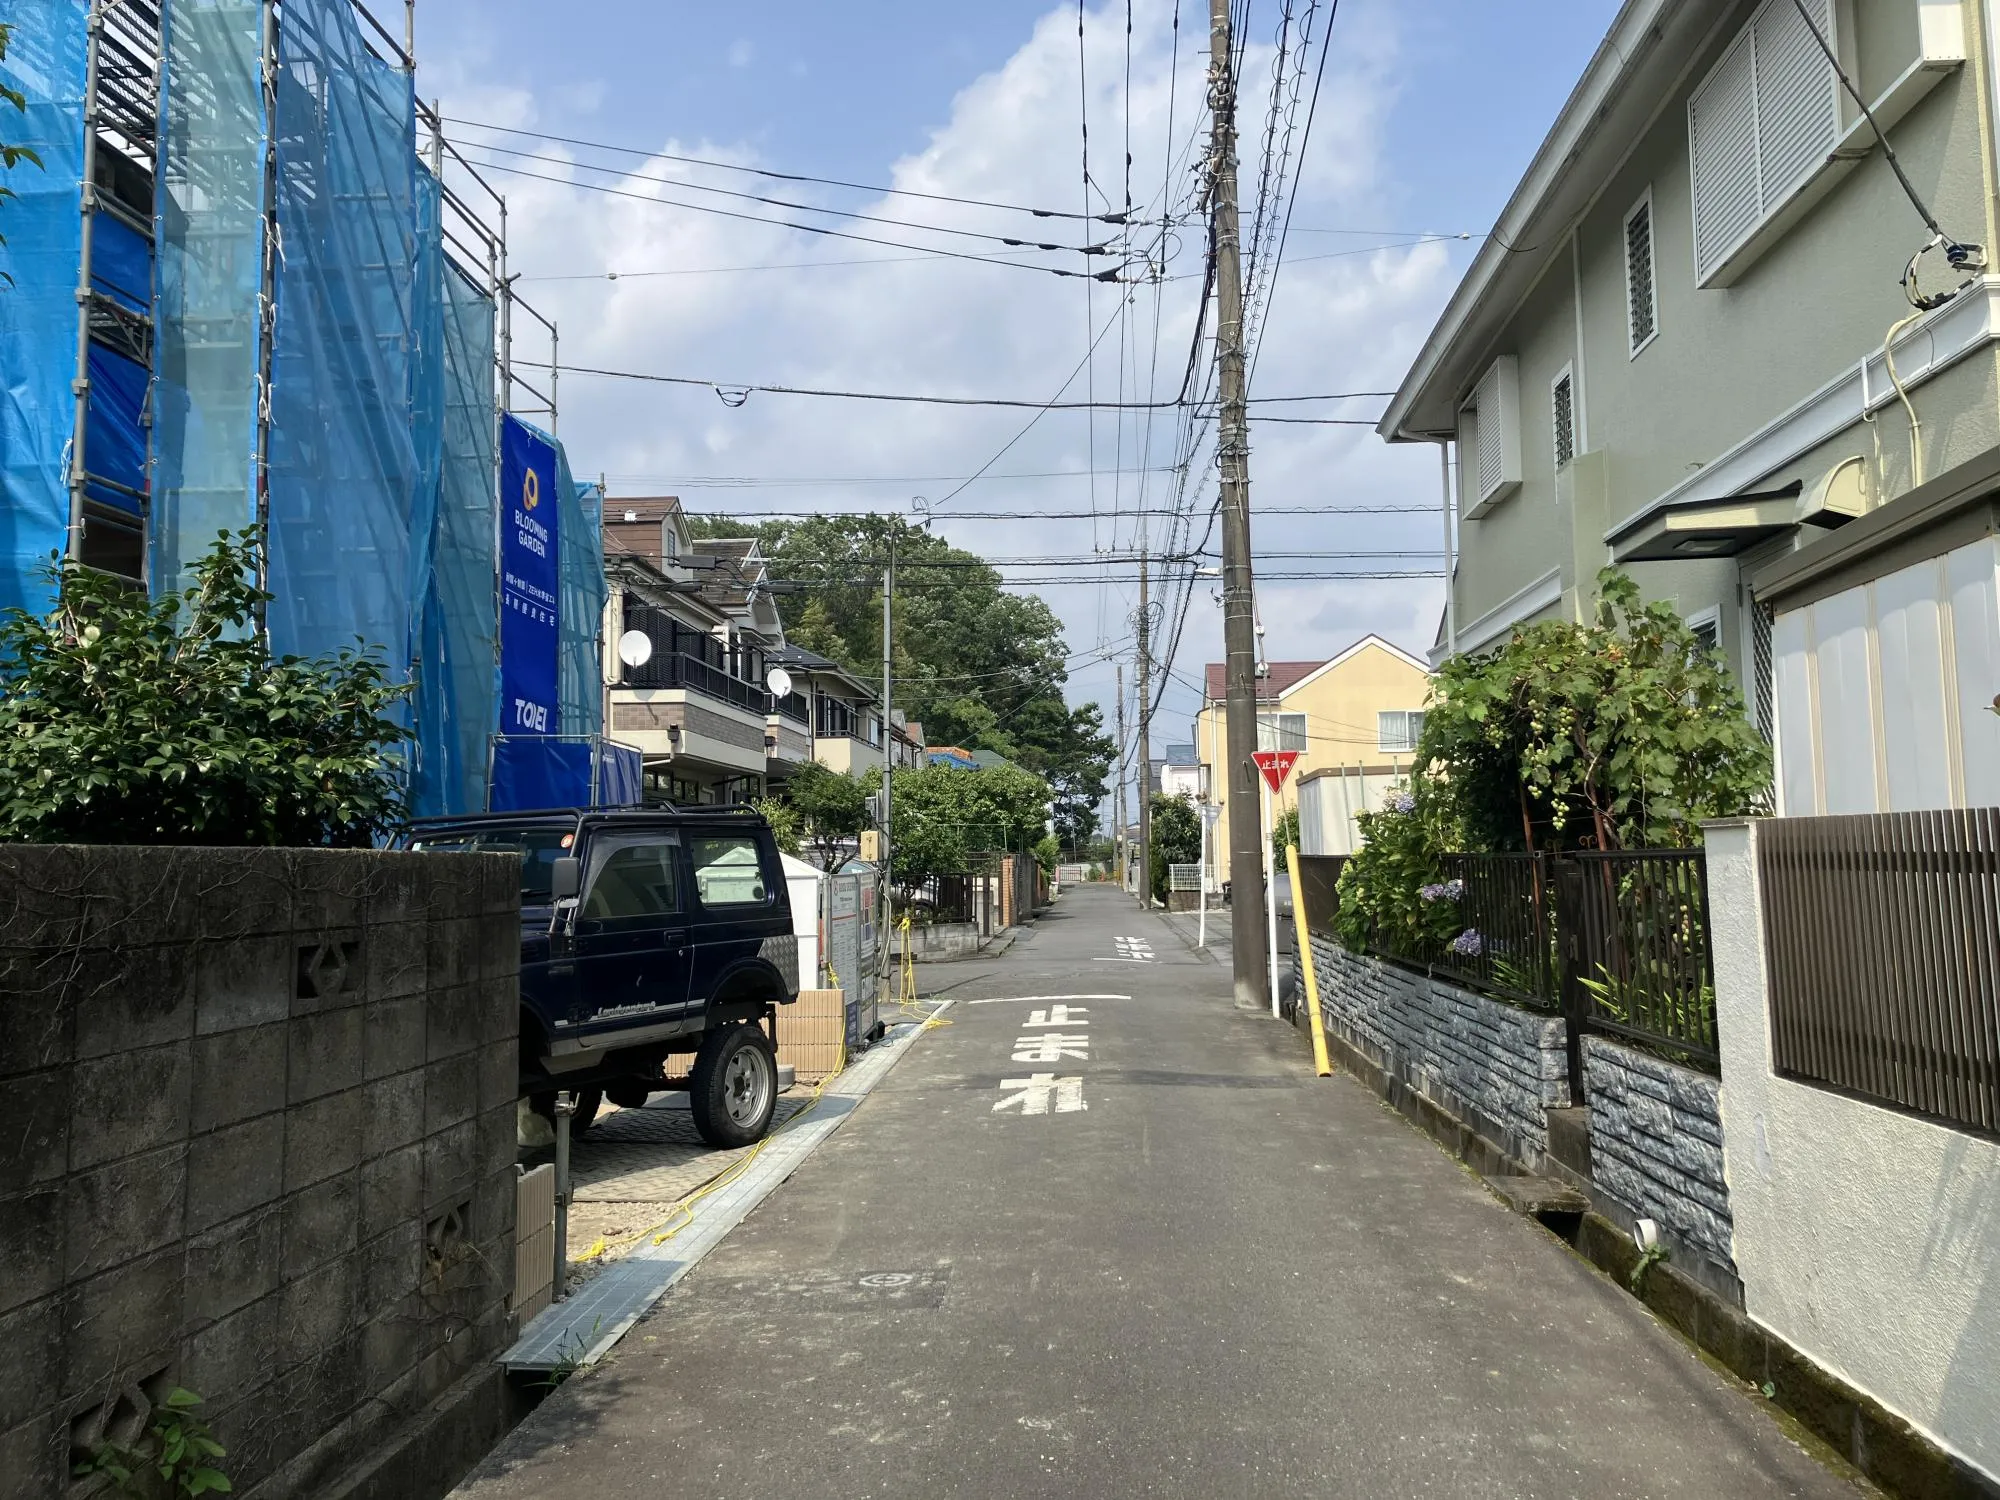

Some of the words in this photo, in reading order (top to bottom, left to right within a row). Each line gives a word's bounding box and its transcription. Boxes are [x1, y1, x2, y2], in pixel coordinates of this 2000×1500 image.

[515, 509, 548, 543] BLOOMING
[518, 530, 545, 559] GARDEN
[515, 698, 548, 733] TOEI
[1261, 759, 1290, 770] 止まれ
[991, 1004, 1089, 1116] 止まれ
